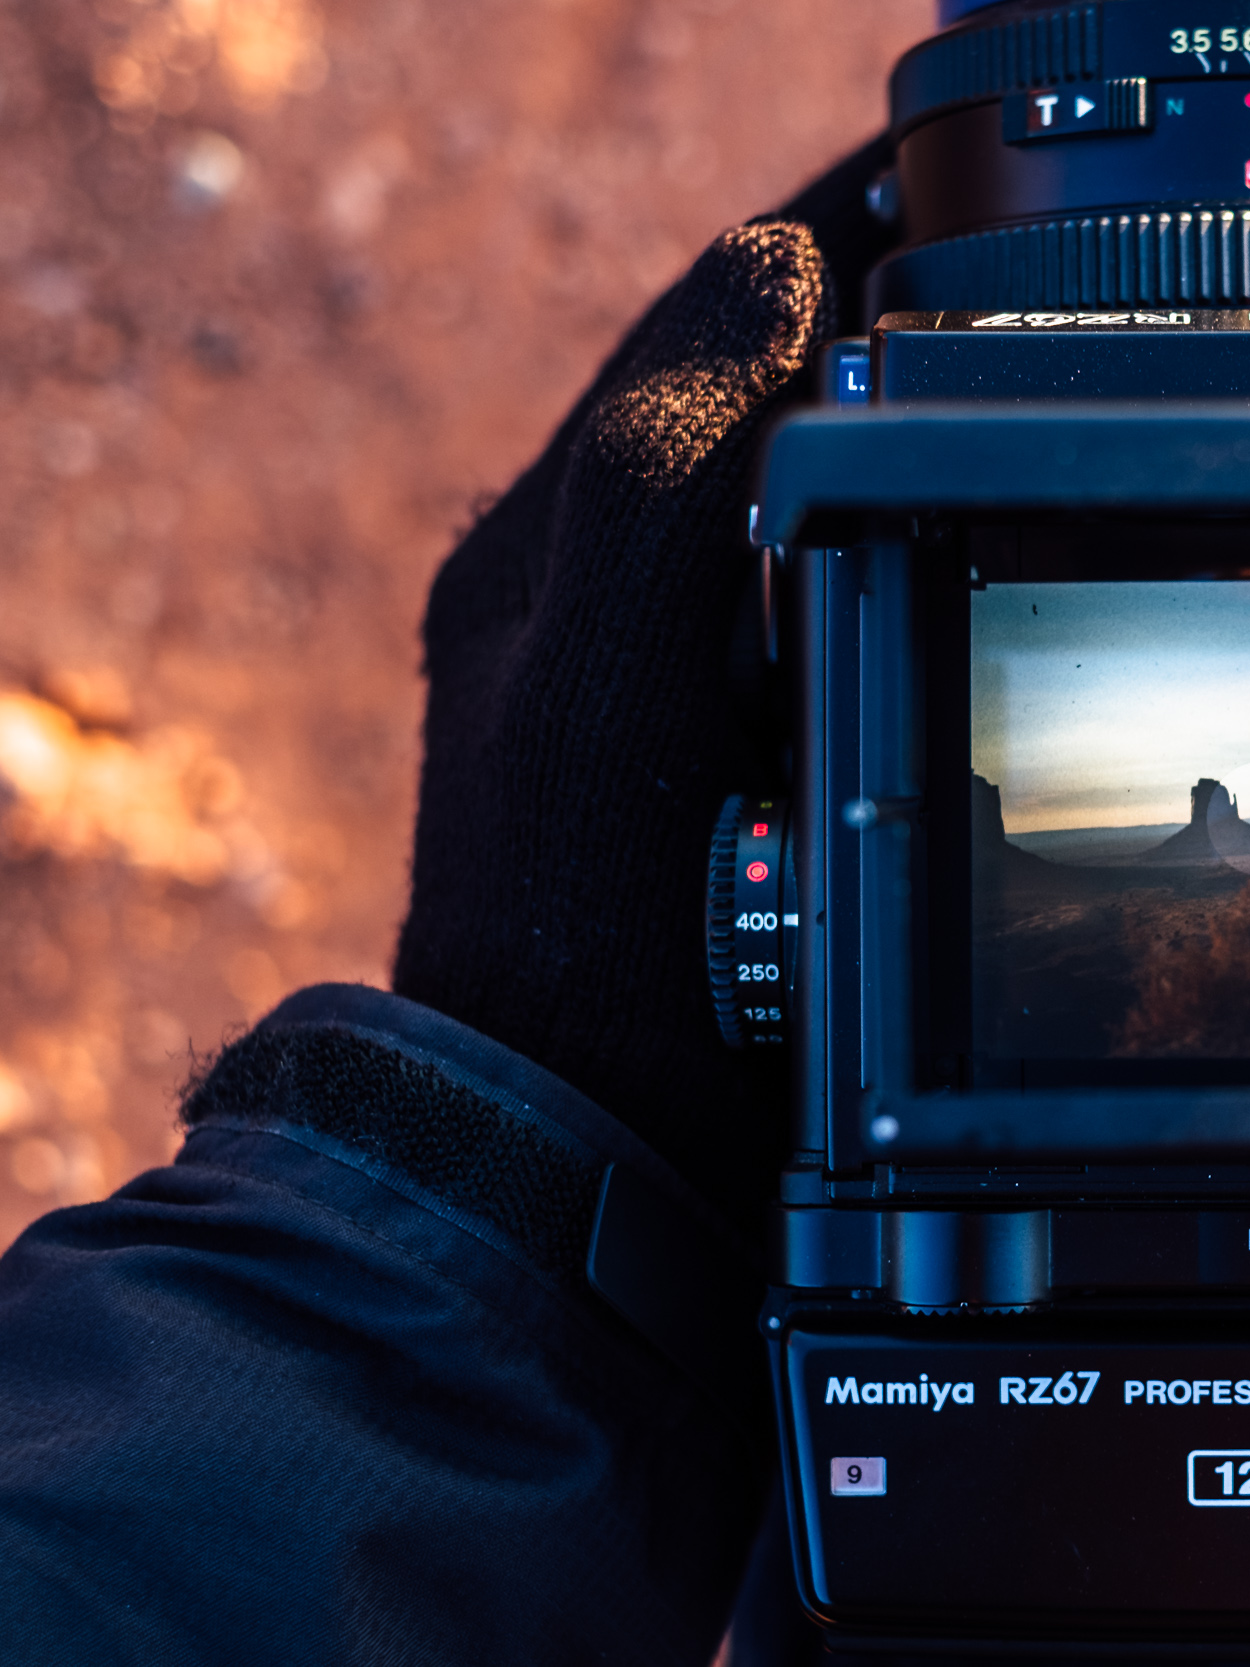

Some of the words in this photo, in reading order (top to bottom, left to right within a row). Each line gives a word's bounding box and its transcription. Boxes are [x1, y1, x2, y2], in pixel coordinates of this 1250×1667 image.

[1170, 28, 1211, 53] 3.5
[1035, 95, 1059, 126] T
[1166, 99, 1184, 116] N
[753, 823, 769, 837] B
[736, 912, 778, 931] 400
[738, 964, 780, 981] 250
[745, 1007, 782, 1021] 125
[824, 1374, 975, 1411] Mamiya
[1000, 1370, 1101, 1405] RZ67
[846, 1464, 863, 1486] 9
